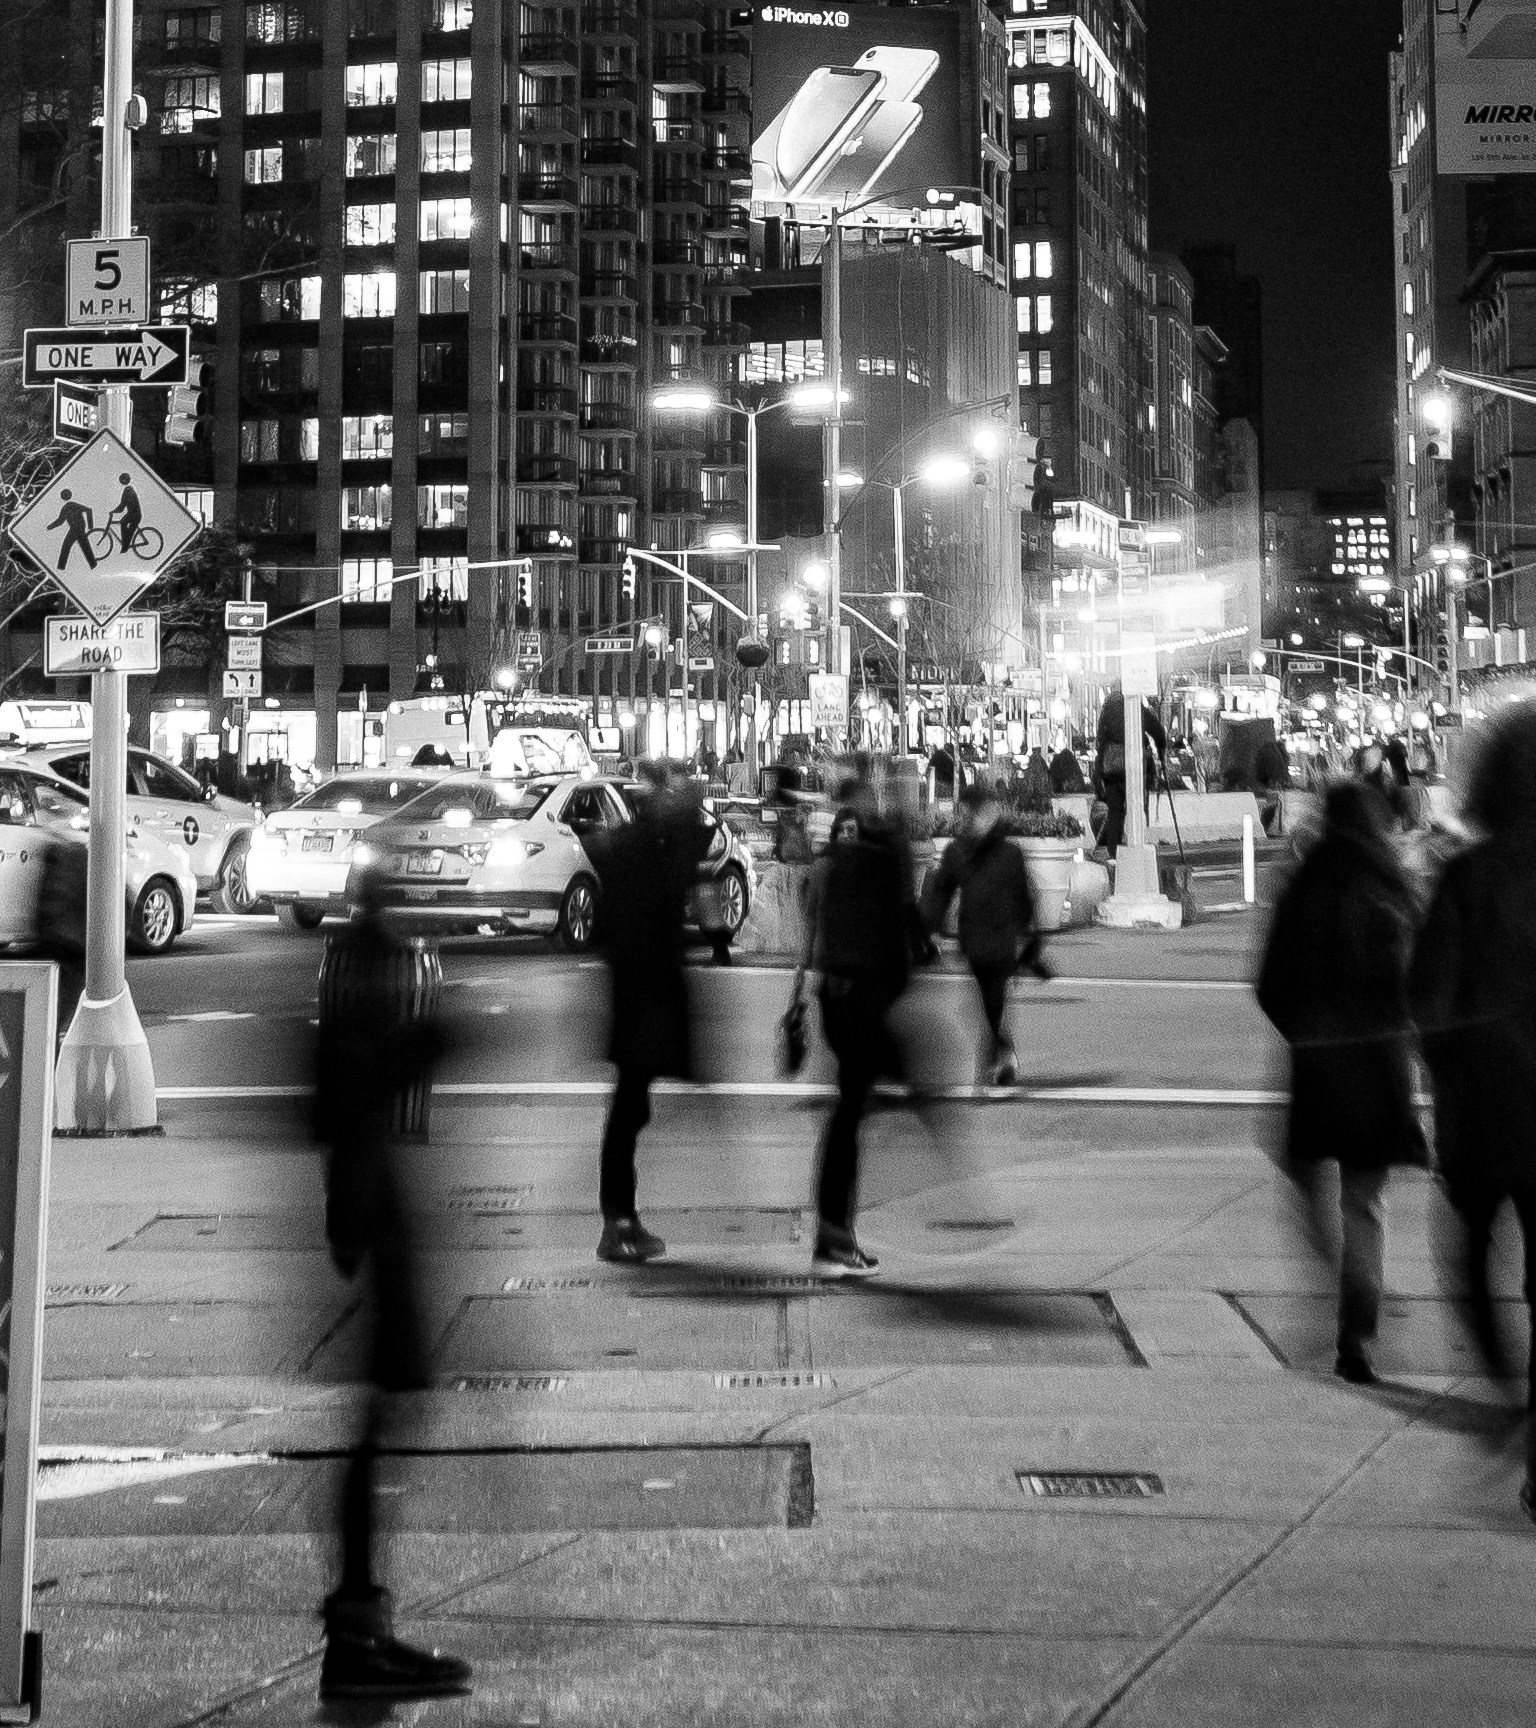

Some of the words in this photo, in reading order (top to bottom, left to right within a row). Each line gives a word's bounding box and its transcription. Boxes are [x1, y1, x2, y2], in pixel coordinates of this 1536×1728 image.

[774, 6, 822, 25] iPhone
[94, 249, 122, 291] 5
[79, 297, 136, 316] M.P.H.
[48, 346, 94, 368] ONE
[115, 345, 163, 367] WAY
[66, 401, 88, 428] ONE
[59, 623, 109, 641] SHARE
[118, 623, 144, 640] THE
[81, 645, 122, 664] ROAD
[815, 712, 844, 722] AHEAD
[818, 703, 841, 712] LANE
